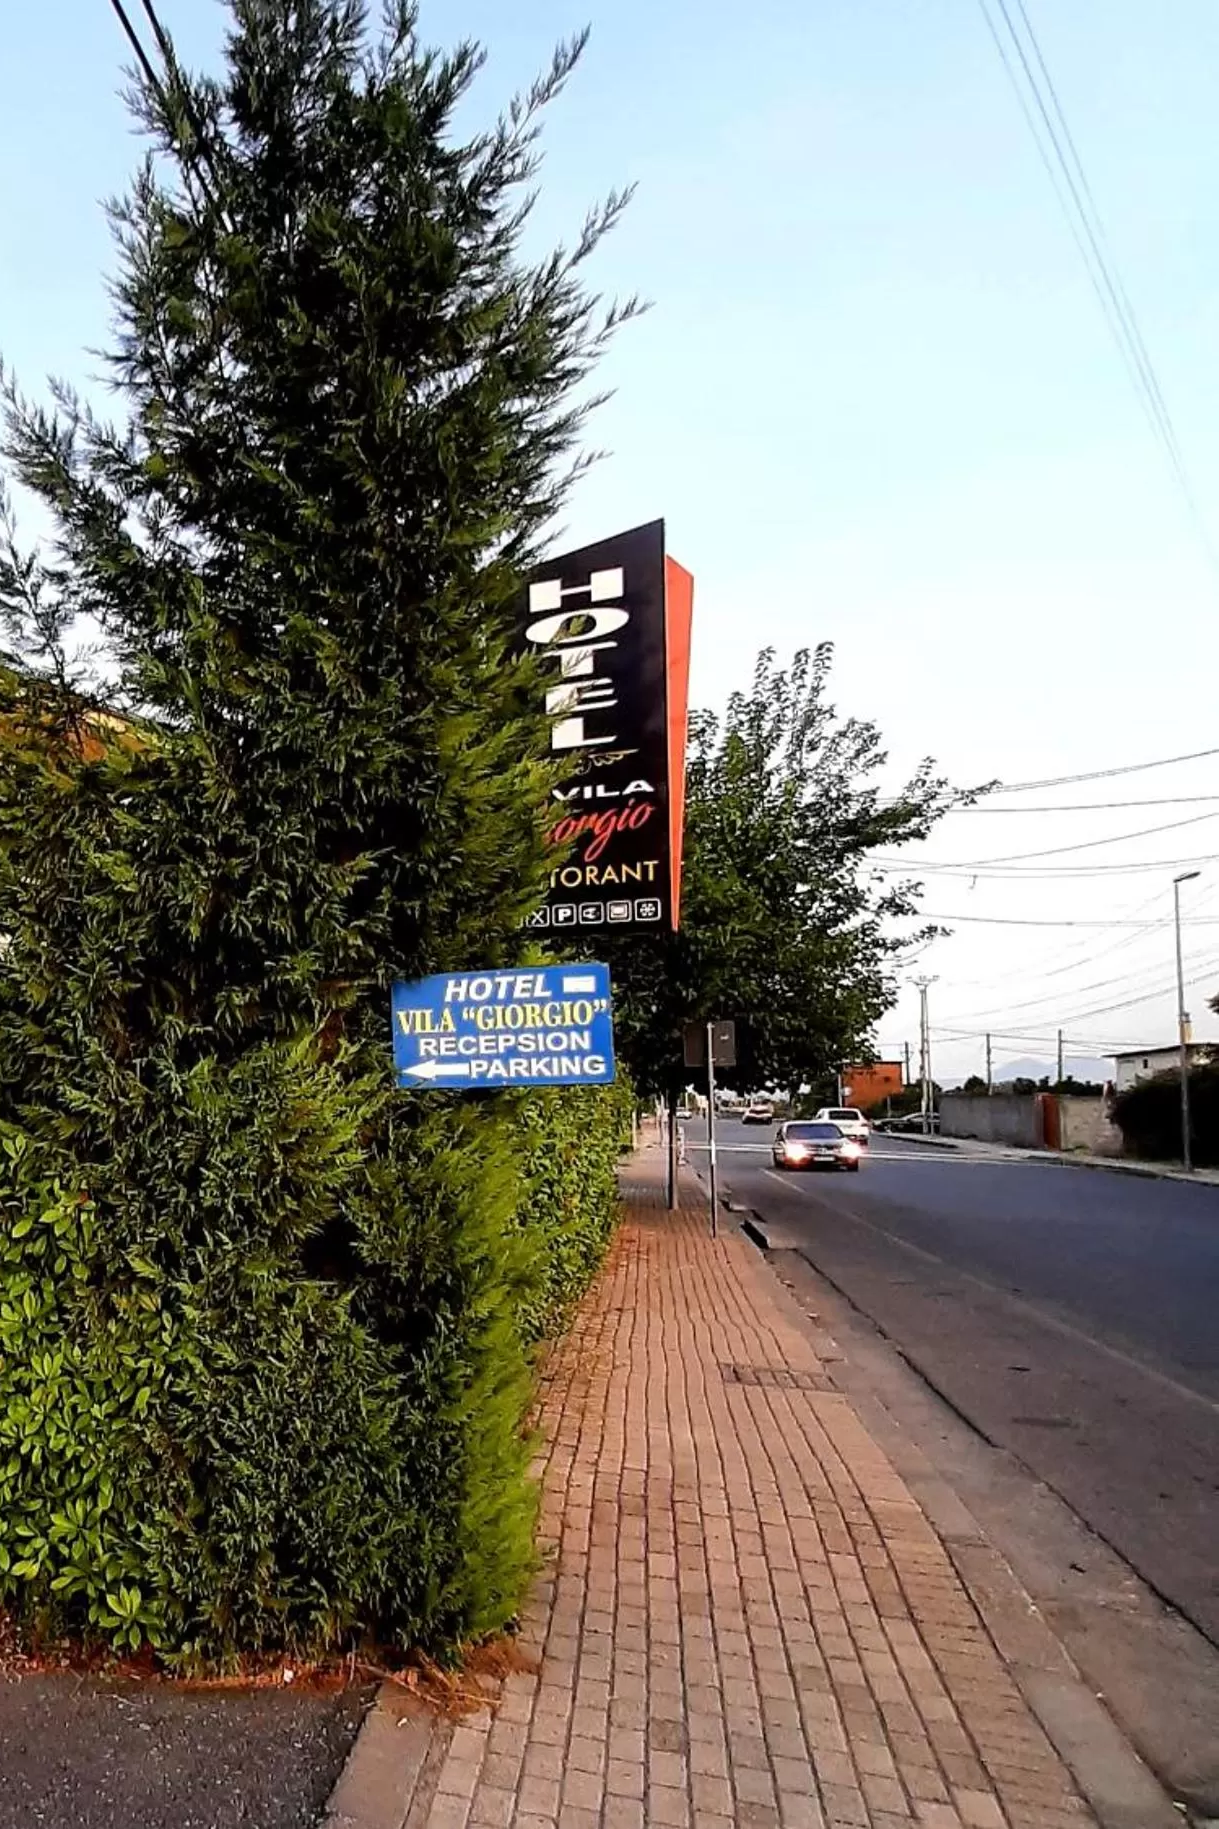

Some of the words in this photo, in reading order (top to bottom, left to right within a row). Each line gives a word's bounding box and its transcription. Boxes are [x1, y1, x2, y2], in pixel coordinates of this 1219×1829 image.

[525, 566, 630, 750] HOTEL
[551, 779, 655, 801] VILA
[543, 797, 654, 863] orgio
[550, 860, 659, 889] TORANT
[444, 974, 552, 1002] HOTEL
[396, 1007, 456, 1035] VILA
[419, 1031, 591, 1057] RECEPSION
[470, 1055, 606, 1079] PARKING
